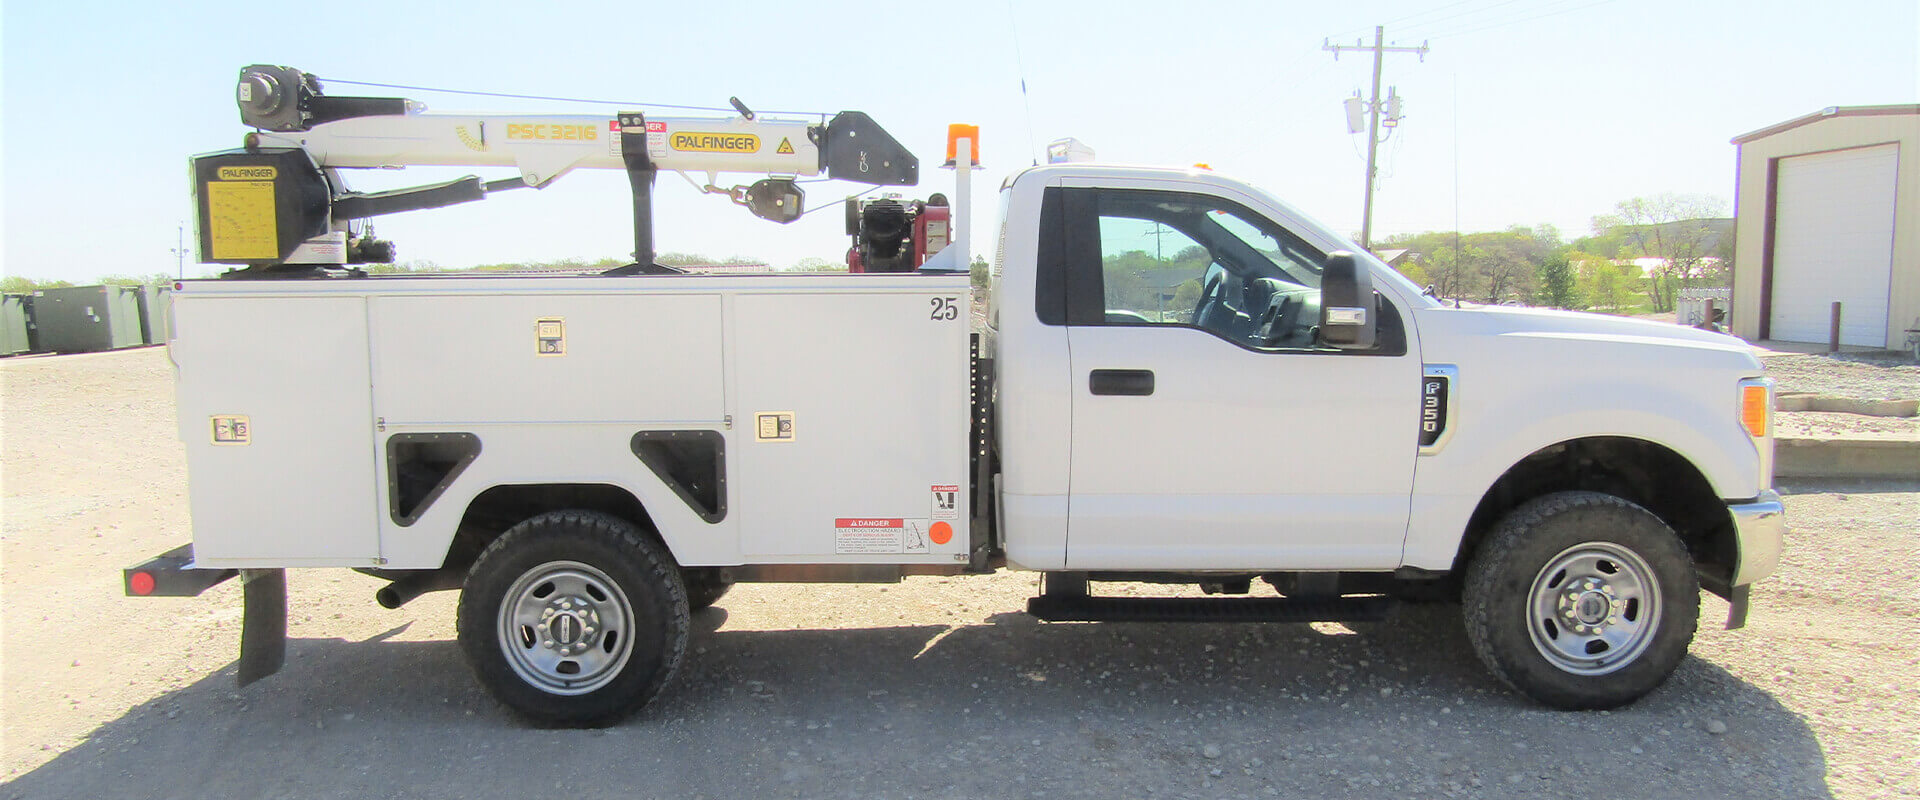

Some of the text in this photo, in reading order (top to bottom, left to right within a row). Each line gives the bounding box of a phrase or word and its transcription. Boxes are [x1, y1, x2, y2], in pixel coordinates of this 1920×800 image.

[507, 124, 598, 141] PSC 3216
[676, 136, 755, 150] PALFINGER
[222, 169, 272, 177] PALFINGER
[931, 297, 958, 320] 25
